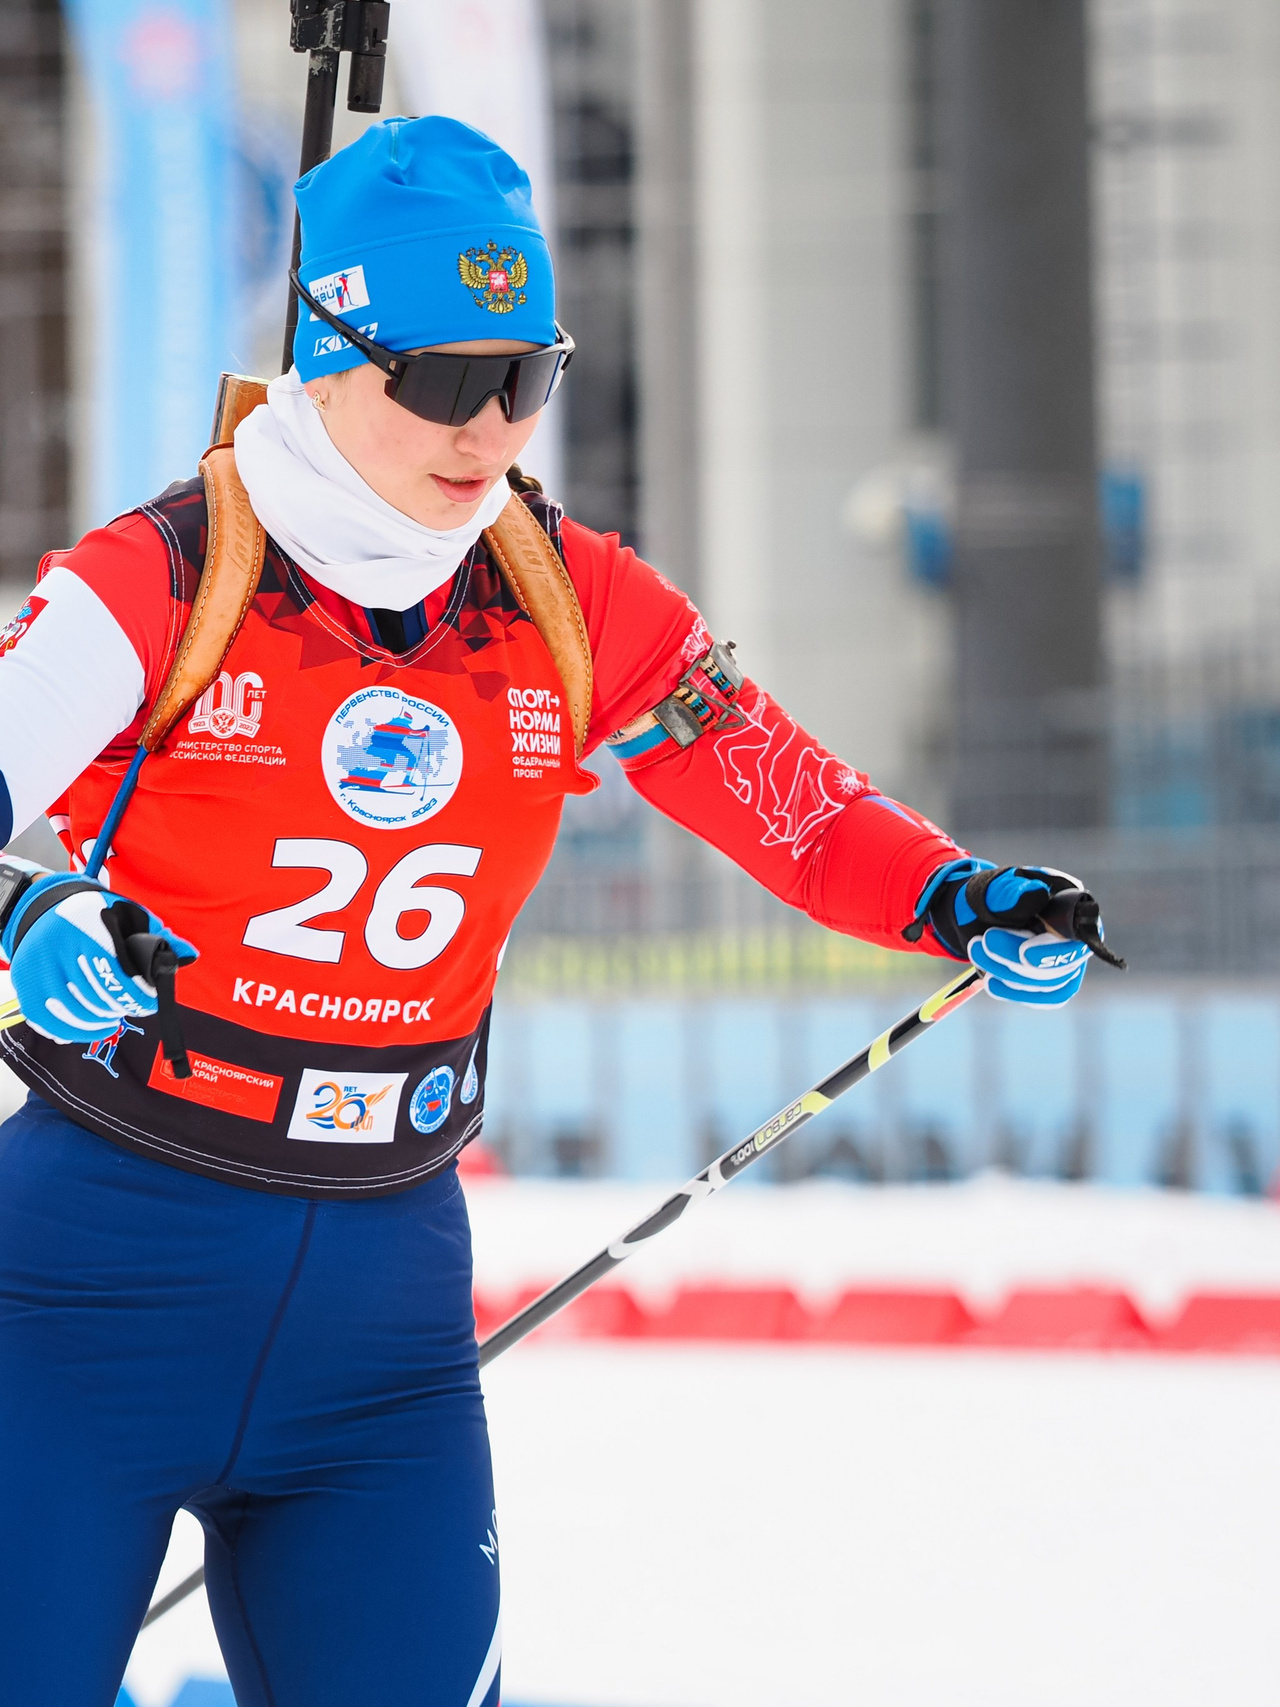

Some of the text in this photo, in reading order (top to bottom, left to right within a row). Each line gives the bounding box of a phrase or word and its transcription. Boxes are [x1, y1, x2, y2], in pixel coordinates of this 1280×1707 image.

[246, 690, 267, 699] ЛЕТ
[507, 687, 551, 710] СПОРТ
[335, 690, 450, 727] ПЕРВЕНСТВО РОССИИ
[509, 709, 561, 733] НОРМА
[244, 745, 283, 755] СПОРТА
[511, 732, 561, 756] ЖИЗНИ
[224, 754, 287, 766] ФЕДЕРАЦИИ
[513, 768, 543, 779] ПРОЕКТ
[347, 799, 407, 824] Красноярск
[411, 797, 438, 818] 2023
[241, 838, 483, 970] 26
[1038, 950, 1077, 968] SKI
[92, 956, 124, 991] SKI
[232, 977, 435, 1024] КРАСНОЯРСК
[192, 1068, 218, 1083] КРАЙ
[193, 1059, 274, 1088] КРАСНОЯРСКИЙ
[343, 1085, 358, 1093] ЛЕТ
